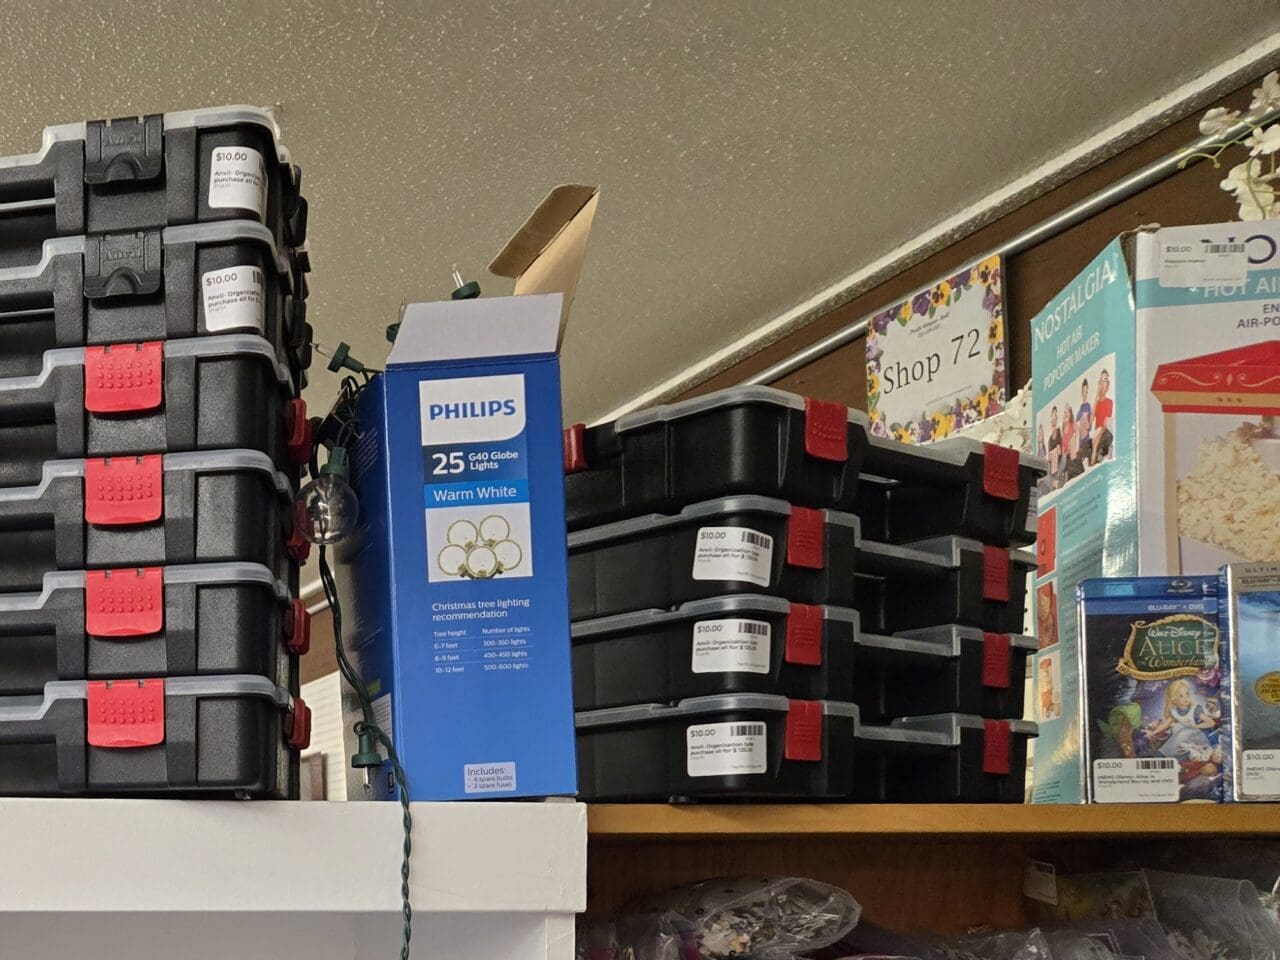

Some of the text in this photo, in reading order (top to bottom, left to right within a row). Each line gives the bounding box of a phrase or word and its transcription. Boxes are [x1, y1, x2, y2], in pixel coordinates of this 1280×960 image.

[105, 131, 143, 145] Anvil
[216, 152, 248, 161] $10.00
[104, 247, 142, 261] Anvil
[206, 272, 238, 286] $10.00
[1255, 276, 1280, 294] AI
[1034, 259, 1115, 351] NOSTALGIA
[1262, 303, 1280, 314] EN
[1236, 317, 1280, 329] AIR-PO
[1056, 332, 1071, 359] HOT
[883, 352, 941, 395] Shop
[951, 328, 980, 365] 72
[1043, 331, 1100, 393] POPCORN MAKER
[429, 399, 517, 420] PHILIPS
[432, 451, 519, 475] 25 G40 Globe
[469, 461, 499, 471] Lights
[433, 486, 518, 502] Warm White
[700, 531, 726, 540] $10.00
[432, 598, 530, 611] Christmas tree lighting
[432, 609, 509, 622] recommendation
[697, 624, 723, 633] $10.00
[1147, 625, 1201, 639] Walt Disney
[1138, 636, 1209, 656] ALICE
[690, 728, 716, 738] $10.00
